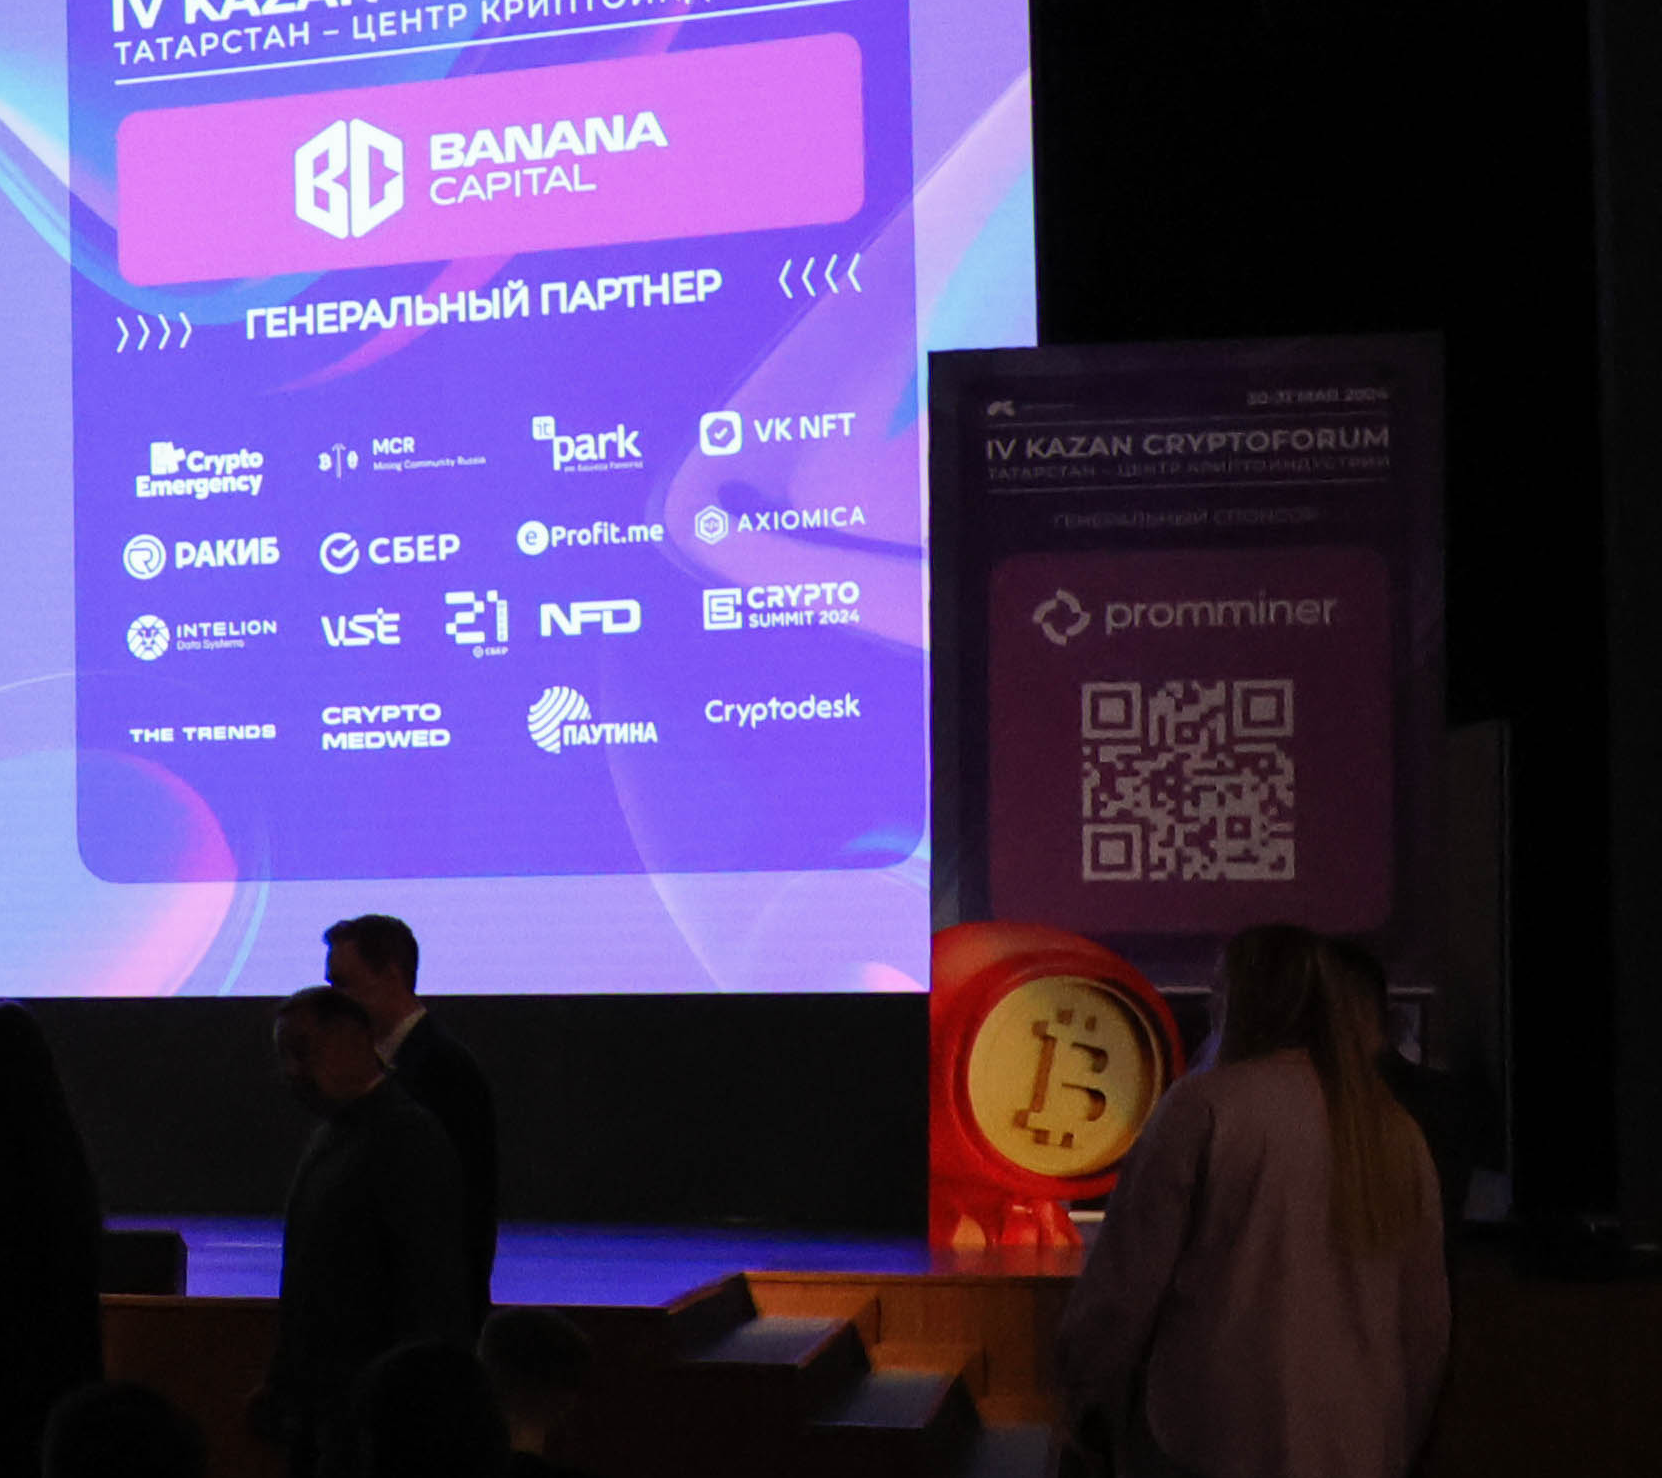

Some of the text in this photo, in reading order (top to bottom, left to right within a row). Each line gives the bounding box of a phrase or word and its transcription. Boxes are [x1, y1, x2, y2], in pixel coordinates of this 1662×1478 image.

[113, 22, 311, 66] ТАТАРСТАН
[350, 4, 468, 45] ЦЕНТР
[429, 110, 669, 171] BANANA
[429, 163, 597, 206] CAPITAL
[245, 267, 722, 340] ГЕНЕРАЛЬНЫЙ ПАРТНЕР
[754, 411, 856, 443] VK NFT
[372, 436, 415, 456] MCR
[553, 423, 643, 472] park
[986, 426, 1389, 460] IV KAZAN CRYPTOFORUM
[186, 447, 264, 475] Crypto
[135, 474, 264, 500] Emergency
[736, 506, 867, 533] AXIOMICA
[368, 533, 461, 565] СБЕР
[551, 521, 665, 549] Profit.me
[174, 535, 281, 570] РАКИБ
[746, 580, 860, 609] CRYPTO
[748, 609, 861, 629] SUMMIT 2024
[1104, 589, 1339, 636] promminer
[176, 619, 277, 639] INTELION
[321, 702, 442, 726] CRYPTO
[704, 692, 861, 729] Cryptodesk
[129, 723, 277, 743] THE TRENDS
[321, 728, 451, 751] MEDWED
[562, 721, 658, 747] ПАУТИНА
